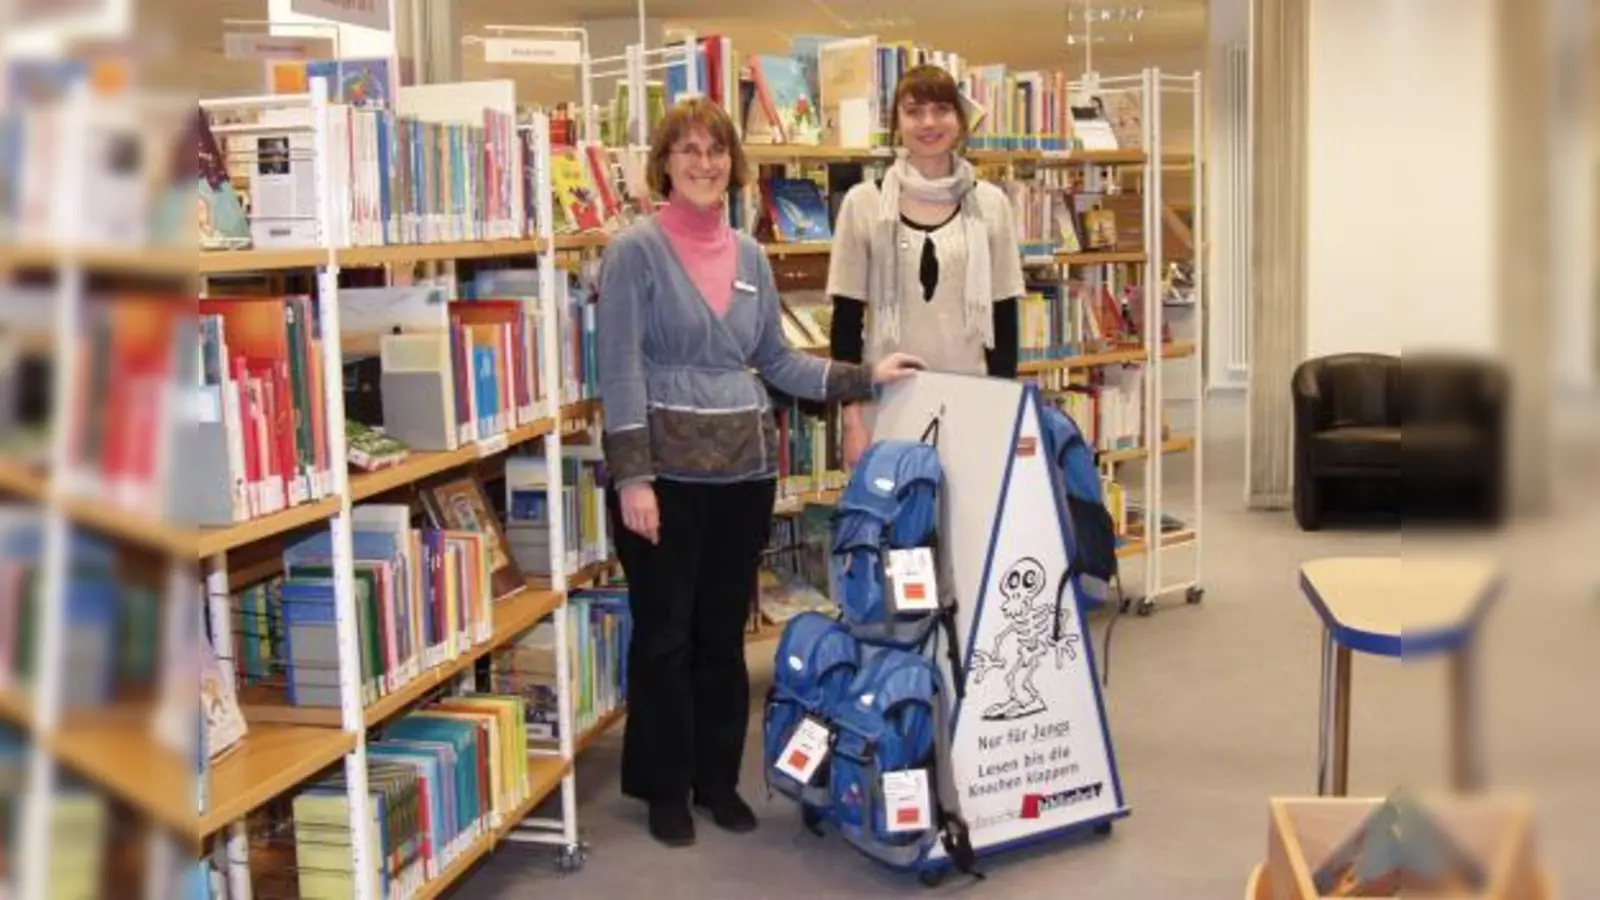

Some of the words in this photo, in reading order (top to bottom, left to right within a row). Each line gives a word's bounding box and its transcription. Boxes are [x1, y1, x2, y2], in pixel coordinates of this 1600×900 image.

[978, 735, 1002, 750] Nur
[1007, 728, 1027, 743] für
[978, 759, 1018, 777] Lesen
[1024, 751, 1044, 767] bis
[1049, 745, 1070, 761] die
[969, 776, 1022, 798] Knochen
